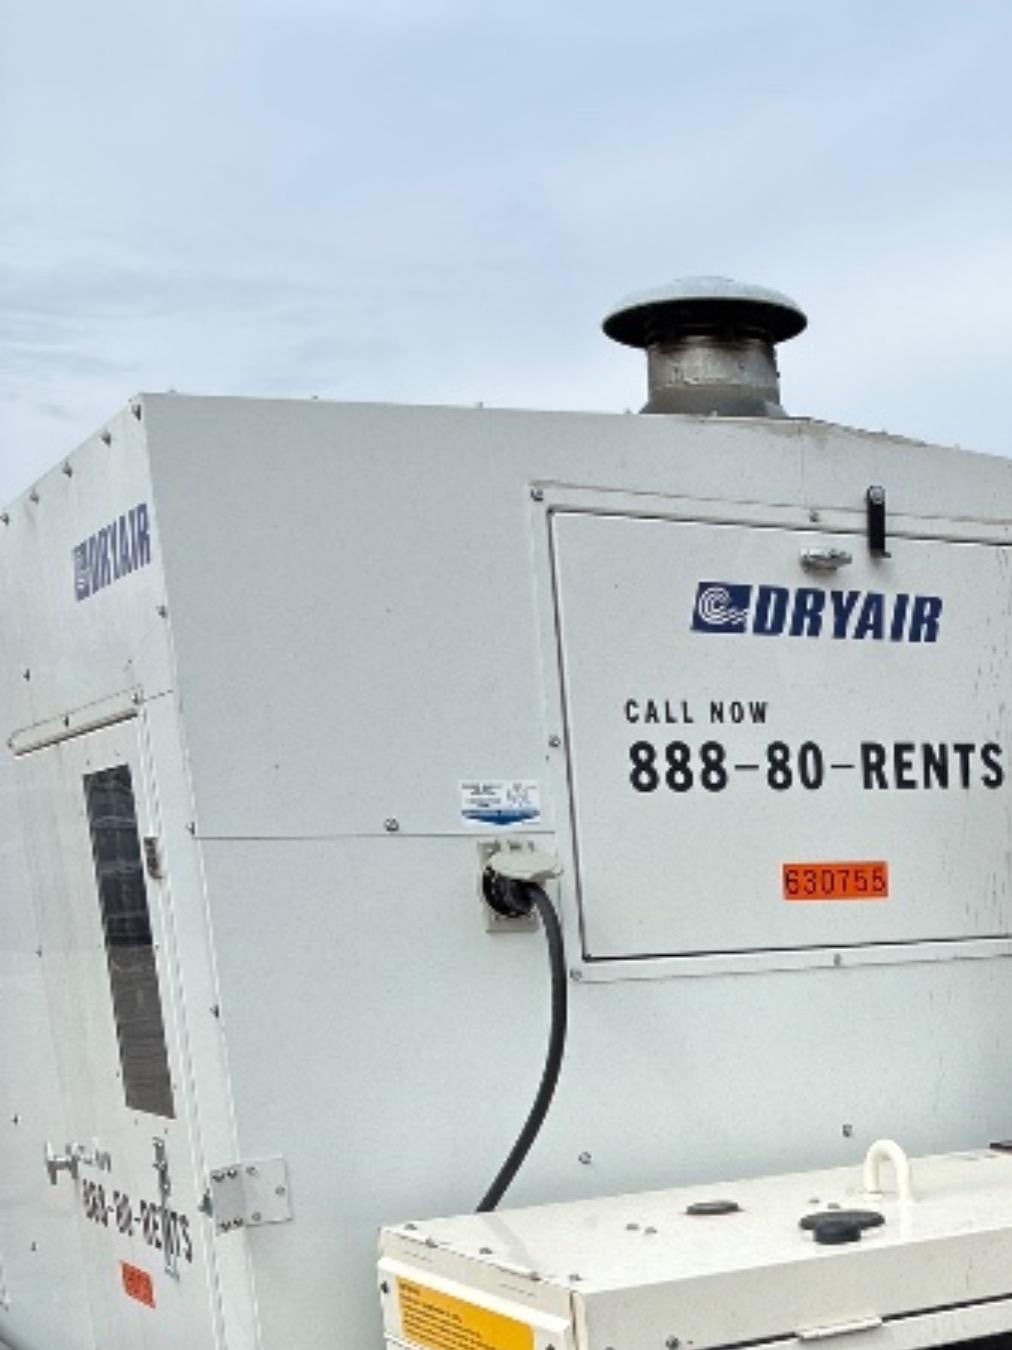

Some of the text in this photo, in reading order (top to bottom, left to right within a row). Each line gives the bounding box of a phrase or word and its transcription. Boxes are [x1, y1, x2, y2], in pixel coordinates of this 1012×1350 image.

[752, 585, 943, 642] DRYAIR
[626, 699, 769, 723] CALL NOW
[629, 741, 1004, 792] 888-80-RENTS
[784, 867, 886, 896] 630755
